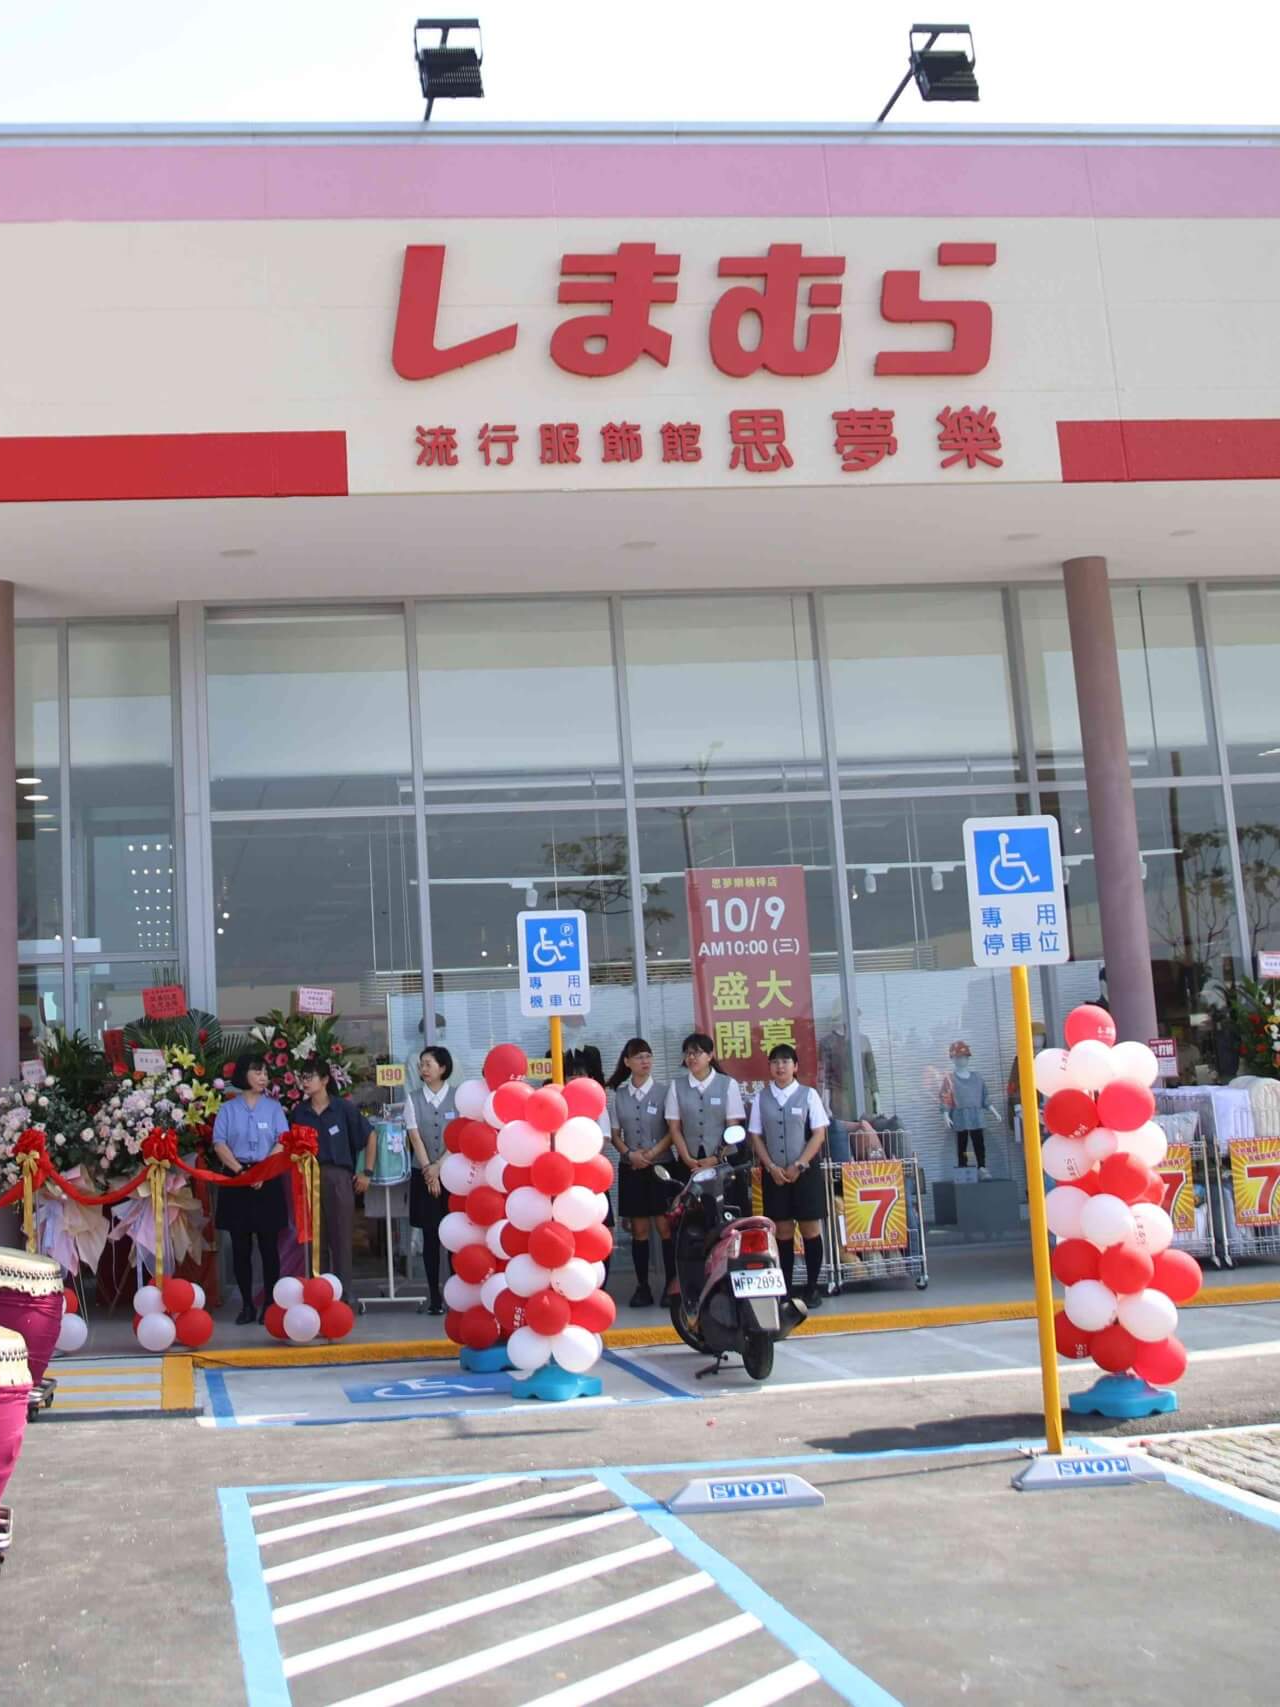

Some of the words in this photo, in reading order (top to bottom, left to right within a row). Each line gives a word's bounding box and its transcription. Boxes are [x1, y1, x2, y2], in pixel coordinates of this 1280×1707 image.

[392, 242, 996, 381] しまむら
[415, 422, 702, 468] 流行服飾館
[728, 405, 1002, 473] 思夢樂
[705, 896, 785, 932] 10/9
[699, 940, 768, 956] AM10:00
[983, 931, 1060, 956] 停車位
[530, 993, 582, 1008] 機車位
[712, 969, 794, 1011] 盛大
[714, 1018, 797, 1060] 開幕
[379, 1068, 402, 1081] 190
[528, 1062, 552, 1075] 190
[1161, 1173, 1185, 1216] 7
[1246, 1165, 1280, 1214] 7
[859, 1188, 897, 1239] 7
[1060, 1459, 1128, 1477] STOP
[711, 1481, 785, 1499] STOP
